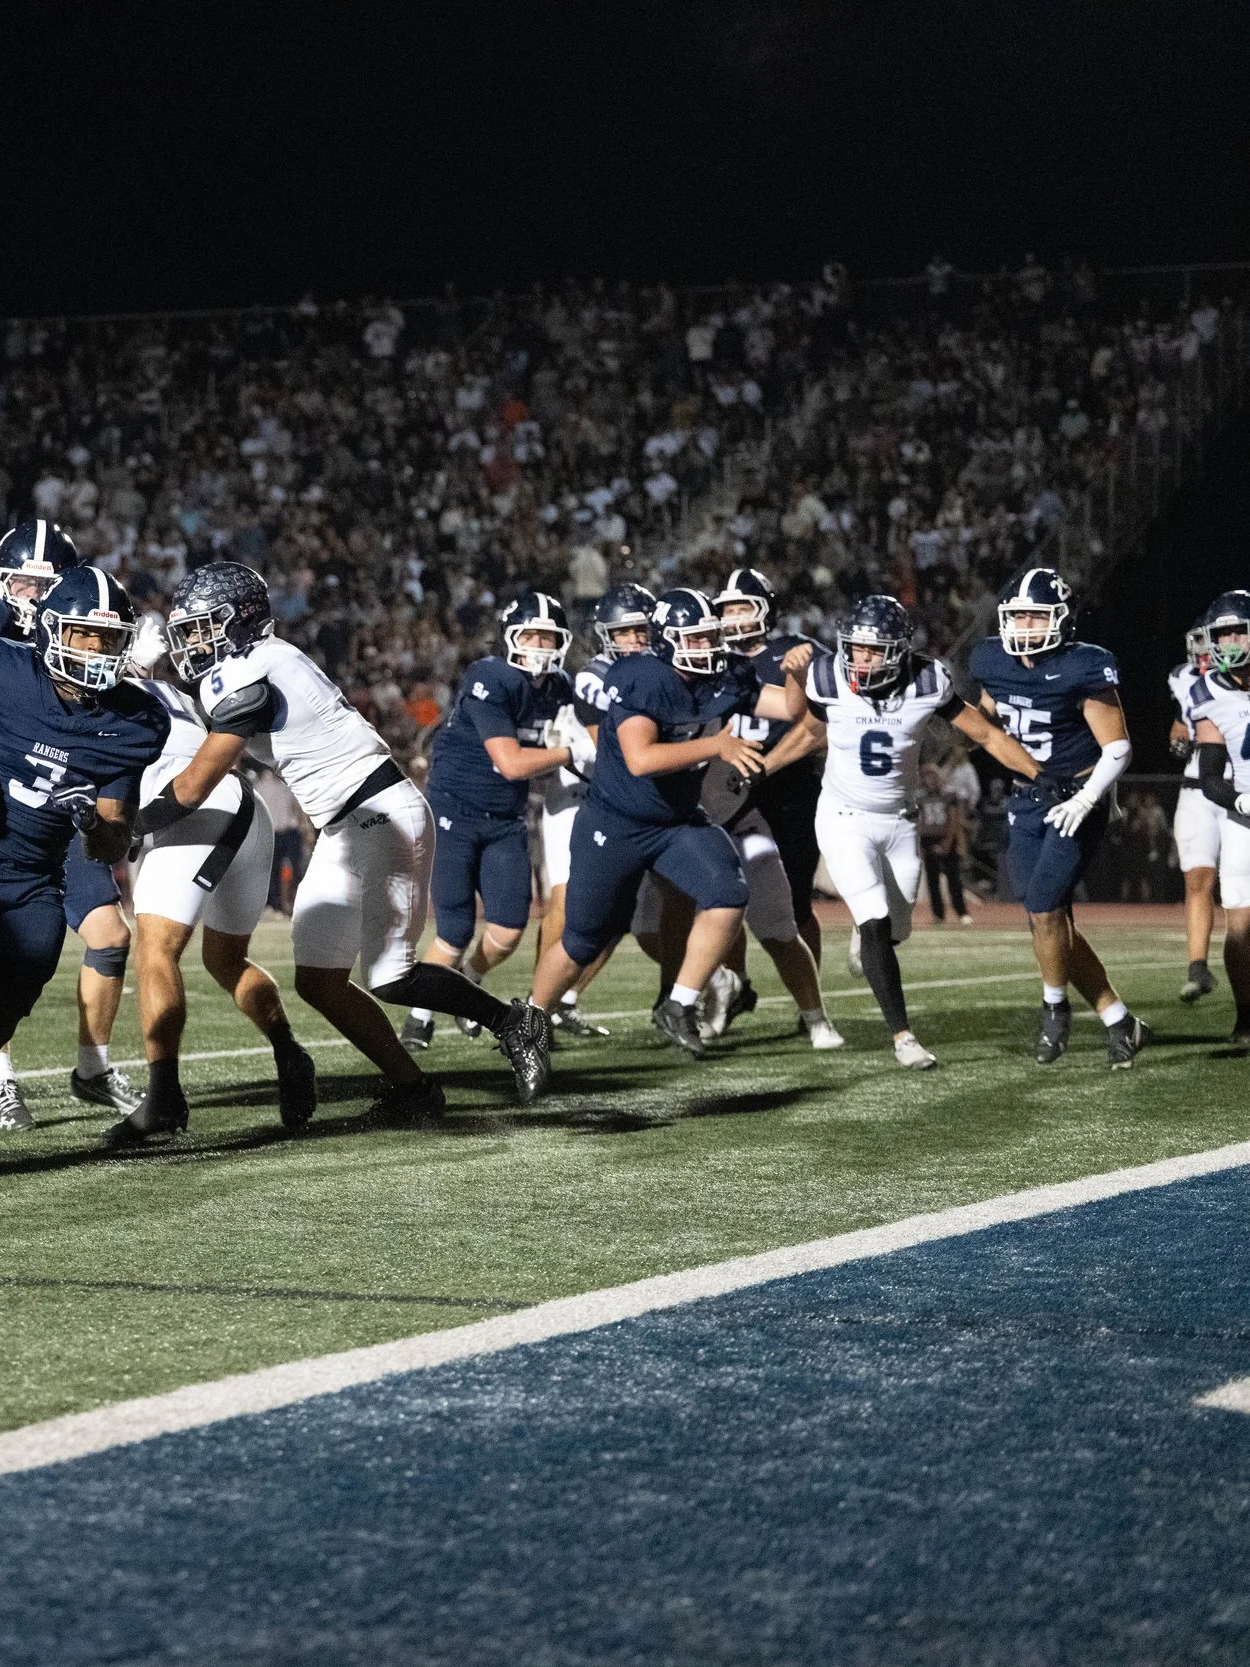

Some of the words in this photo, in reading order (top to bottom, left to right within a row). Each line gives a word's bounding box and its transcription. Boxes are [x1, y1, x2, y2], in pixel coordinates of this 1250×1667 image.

[25, 563, 52, 572] Riddell
[93, 610, 118, 620] Riddell
[211, 667, 224, 695] 5
[856, 716, 903, 725] CHAMPION
[32, 741, 70, 764] RANGERS
[860, 729, 894, 777] 6
[8, 754, 67, 809] 3
